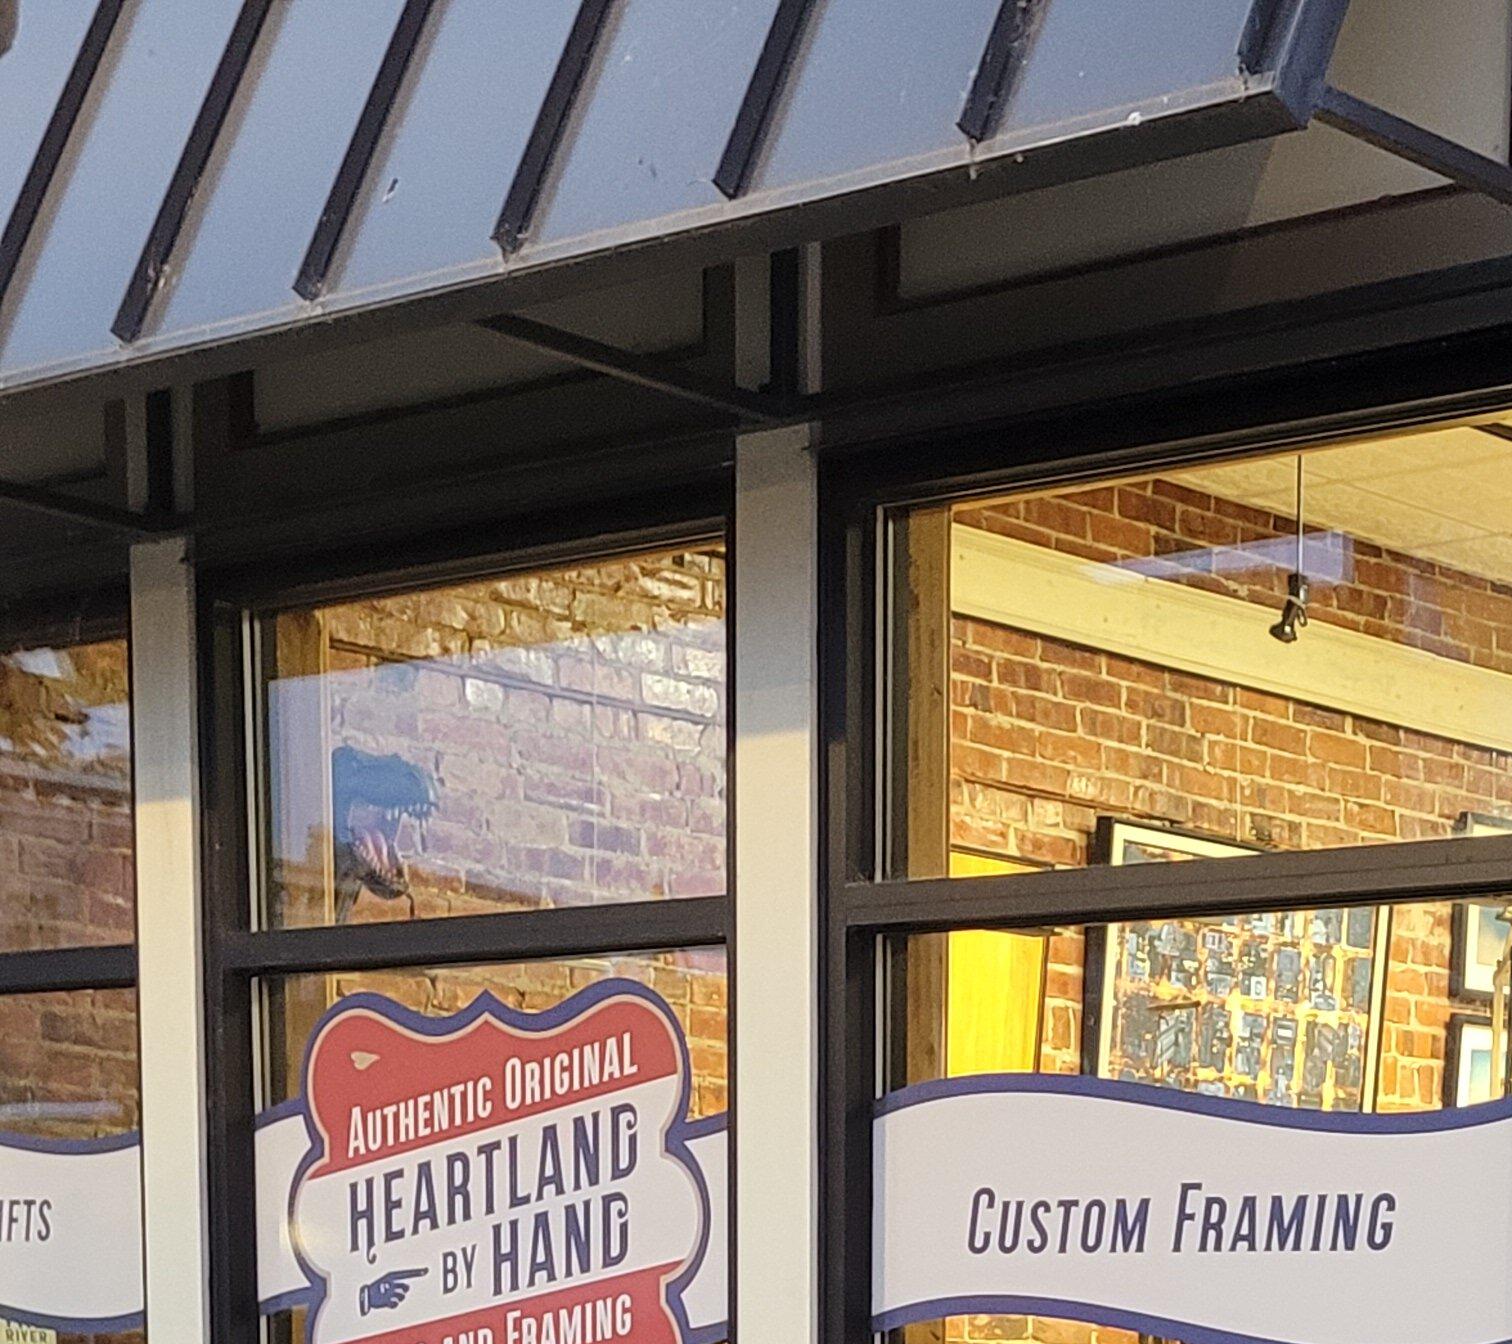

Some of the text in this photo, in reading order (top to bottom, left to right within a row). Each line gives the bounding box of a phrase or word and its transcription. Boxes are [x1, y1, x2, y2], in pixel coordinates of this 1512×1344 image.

[347, 1032, 639, 1160] AUTHENTIC ORIGINAL
[348, 1102, 638, 1264] HEARTLAND
[967, 1181, 1397, 1255] CUSTOM FRAMING
[442, 1191, 630, 1297] BY HAND
